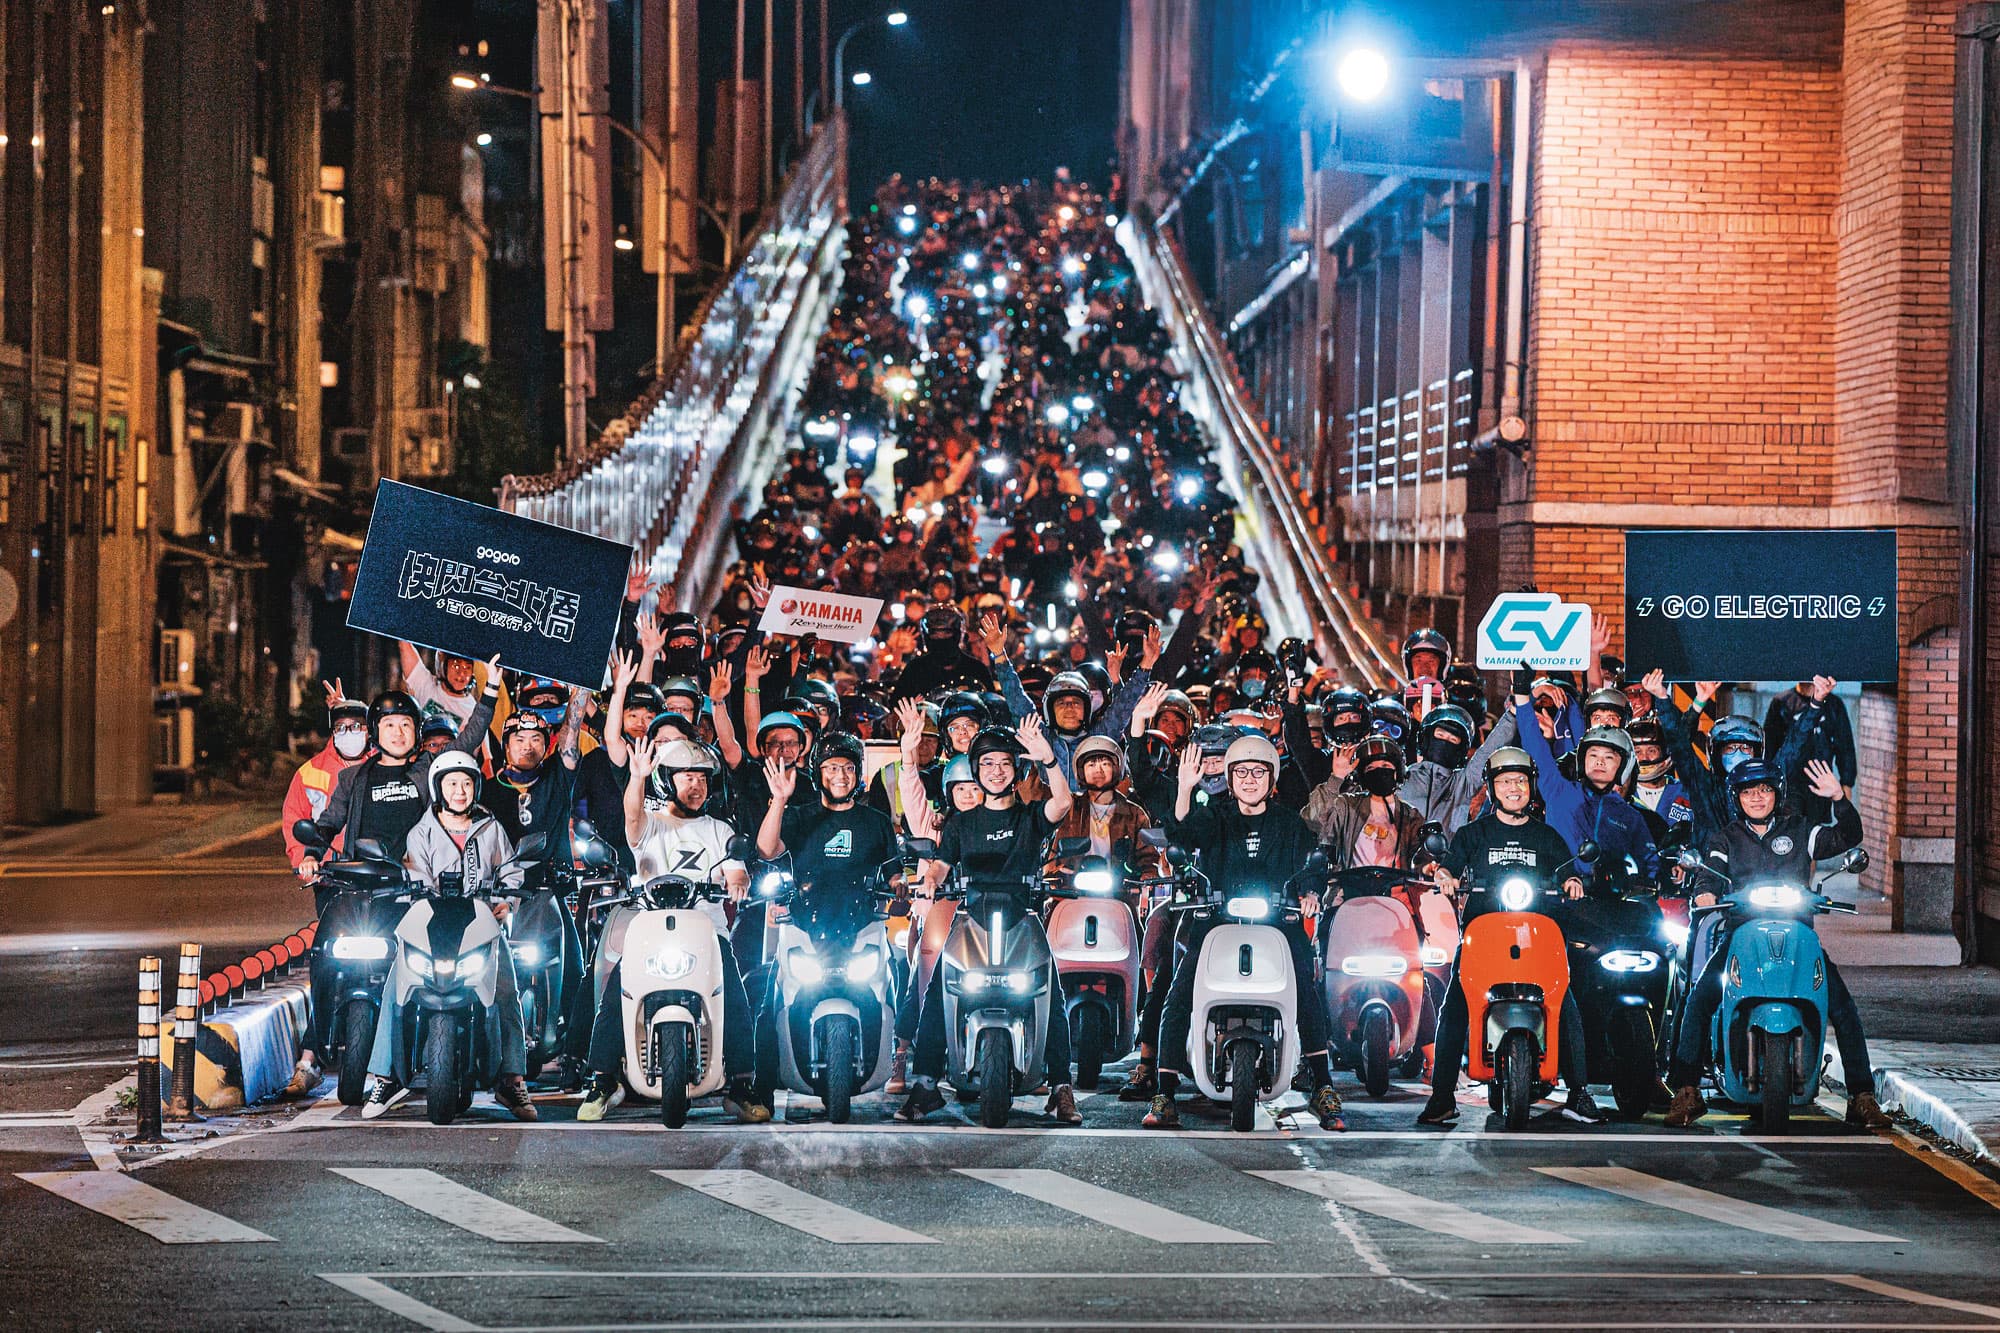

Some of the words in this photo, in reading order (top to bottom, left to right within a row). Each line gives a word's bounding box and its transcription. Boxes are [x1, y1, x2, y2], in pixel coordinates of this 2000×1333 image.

[477, 546, 520, 566] gogoro
[398, 550, 580, 642] 快閃台北橋
[1661, 594, 1709, 619] GO
[1714, 594, 1861, 619] ELECTRIC
[799, 601, 862, 624] YAMAHA
[1530, 657, 1566, 665] MOTOR
[1569, 657, 1582, 665] EV
